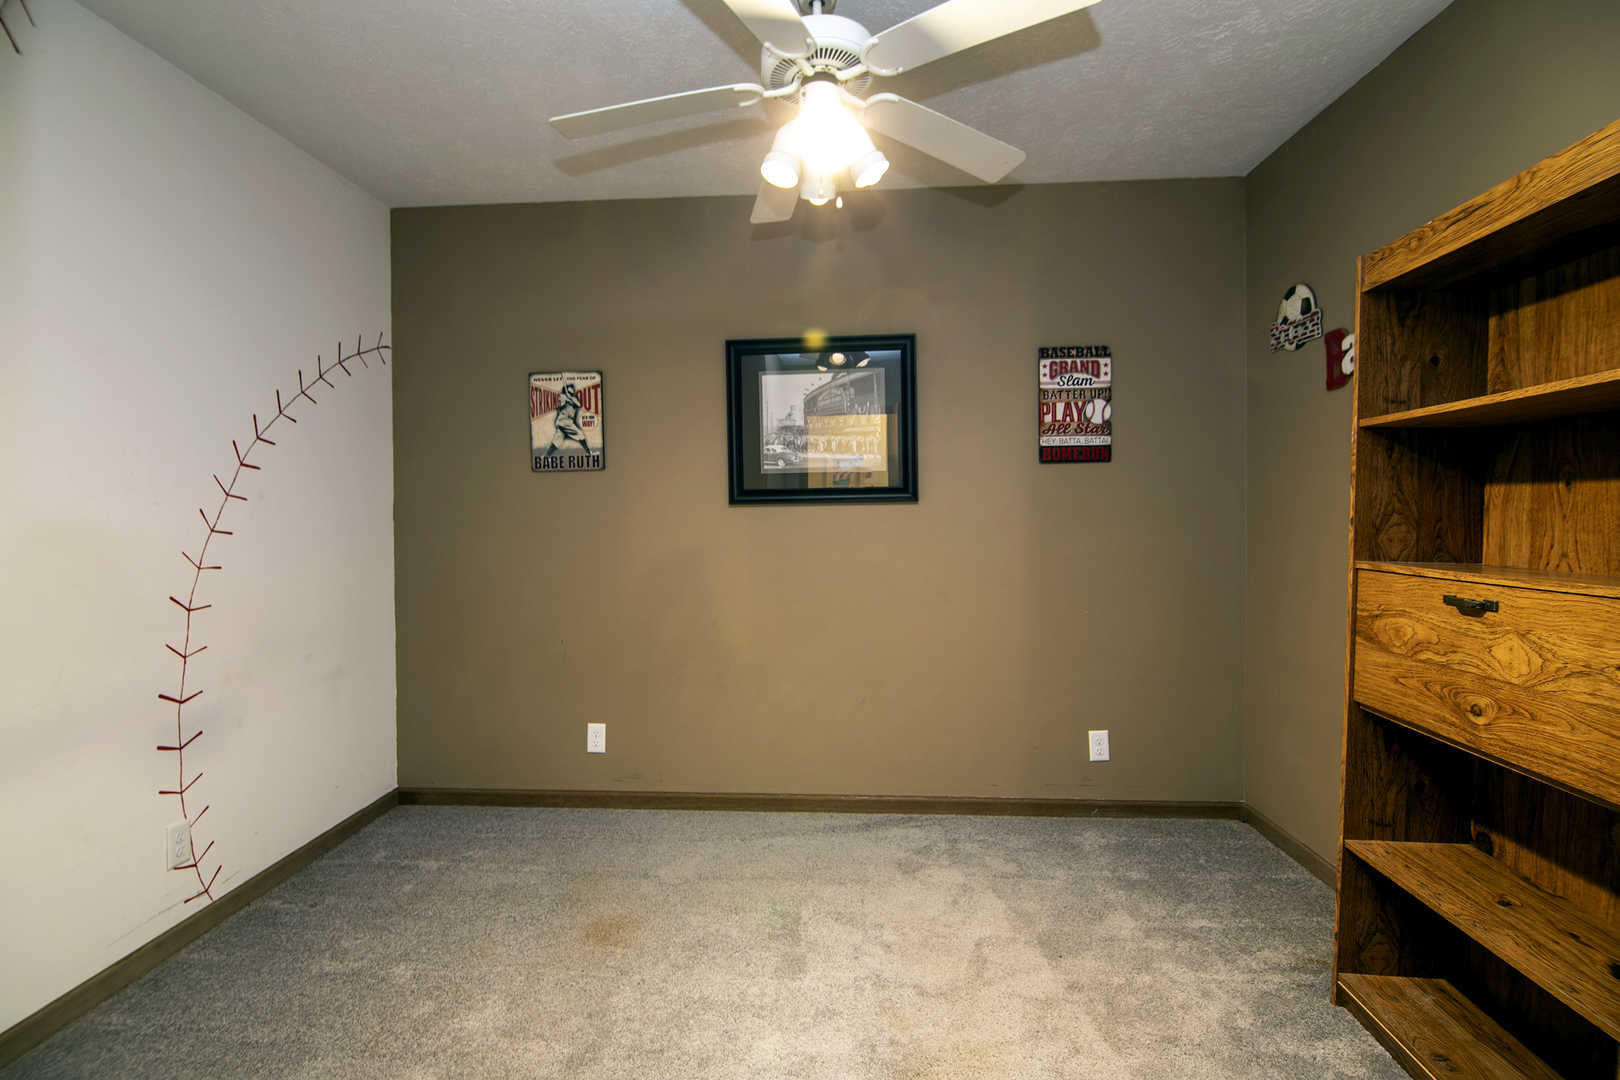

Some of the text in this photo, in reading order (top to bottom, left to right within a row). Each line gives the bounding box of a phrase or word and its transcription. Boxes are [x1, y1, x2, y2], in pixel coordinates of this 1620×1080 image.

[1040, 345, 1111, 358] BASEBALL
[1049, 360, 1101, 380] GRAND
[1057, 374, 1096, 387] Slam
[575, 383, 601, 415] OUT
[1043, 388, 1109, 400] BATTER UP!
[530, 385, 561, 418] STRIKING
[1040, 401, 1087, 423] PLAY
[1042, 422, 1110, 435] All Star
[1041, 436, 1109, 446] HEY, BATTA, BATTA!
[1042, 447, 1109, 461] HOMERUN
[534, 455, 600, 469] BABE RUTH
